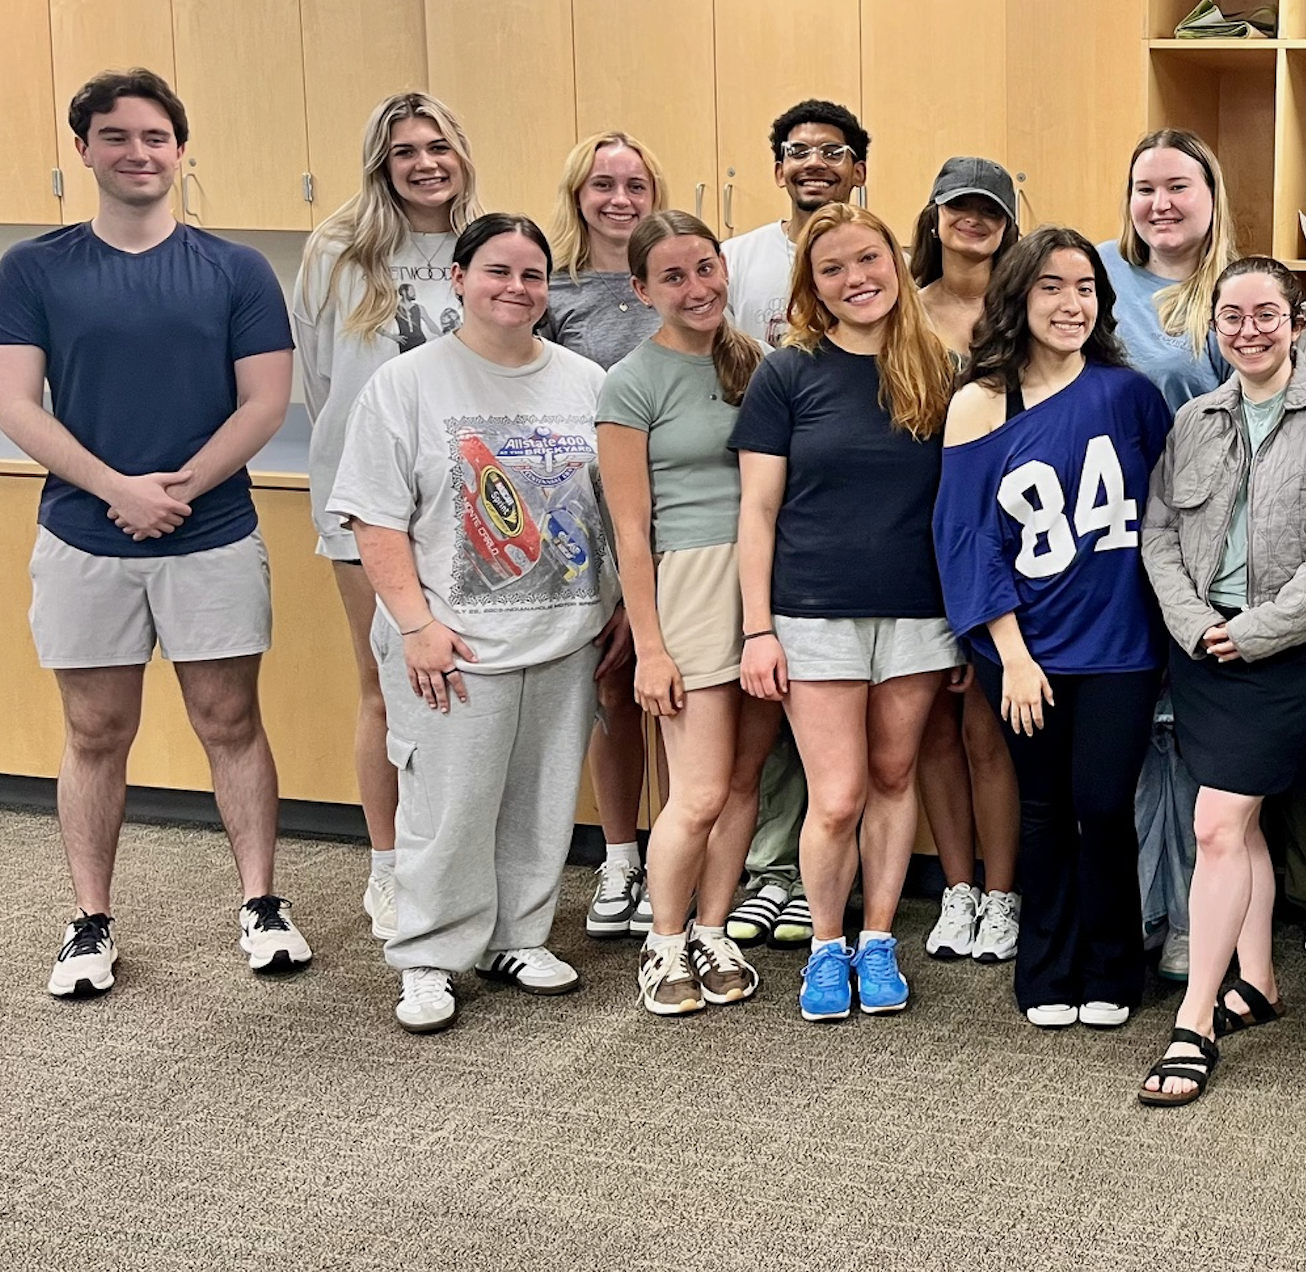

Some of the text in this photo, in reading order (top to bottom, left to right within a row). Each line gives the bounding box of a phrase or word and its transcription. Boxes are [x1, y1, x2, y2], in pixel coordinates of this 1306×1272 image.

[506, 436, 584, 450] Allstate 400
[525, 445, 592, 455] BRICKYARD
[491, 491, 510, 516] Sprint
[997, 434, 1138, 579] 84
